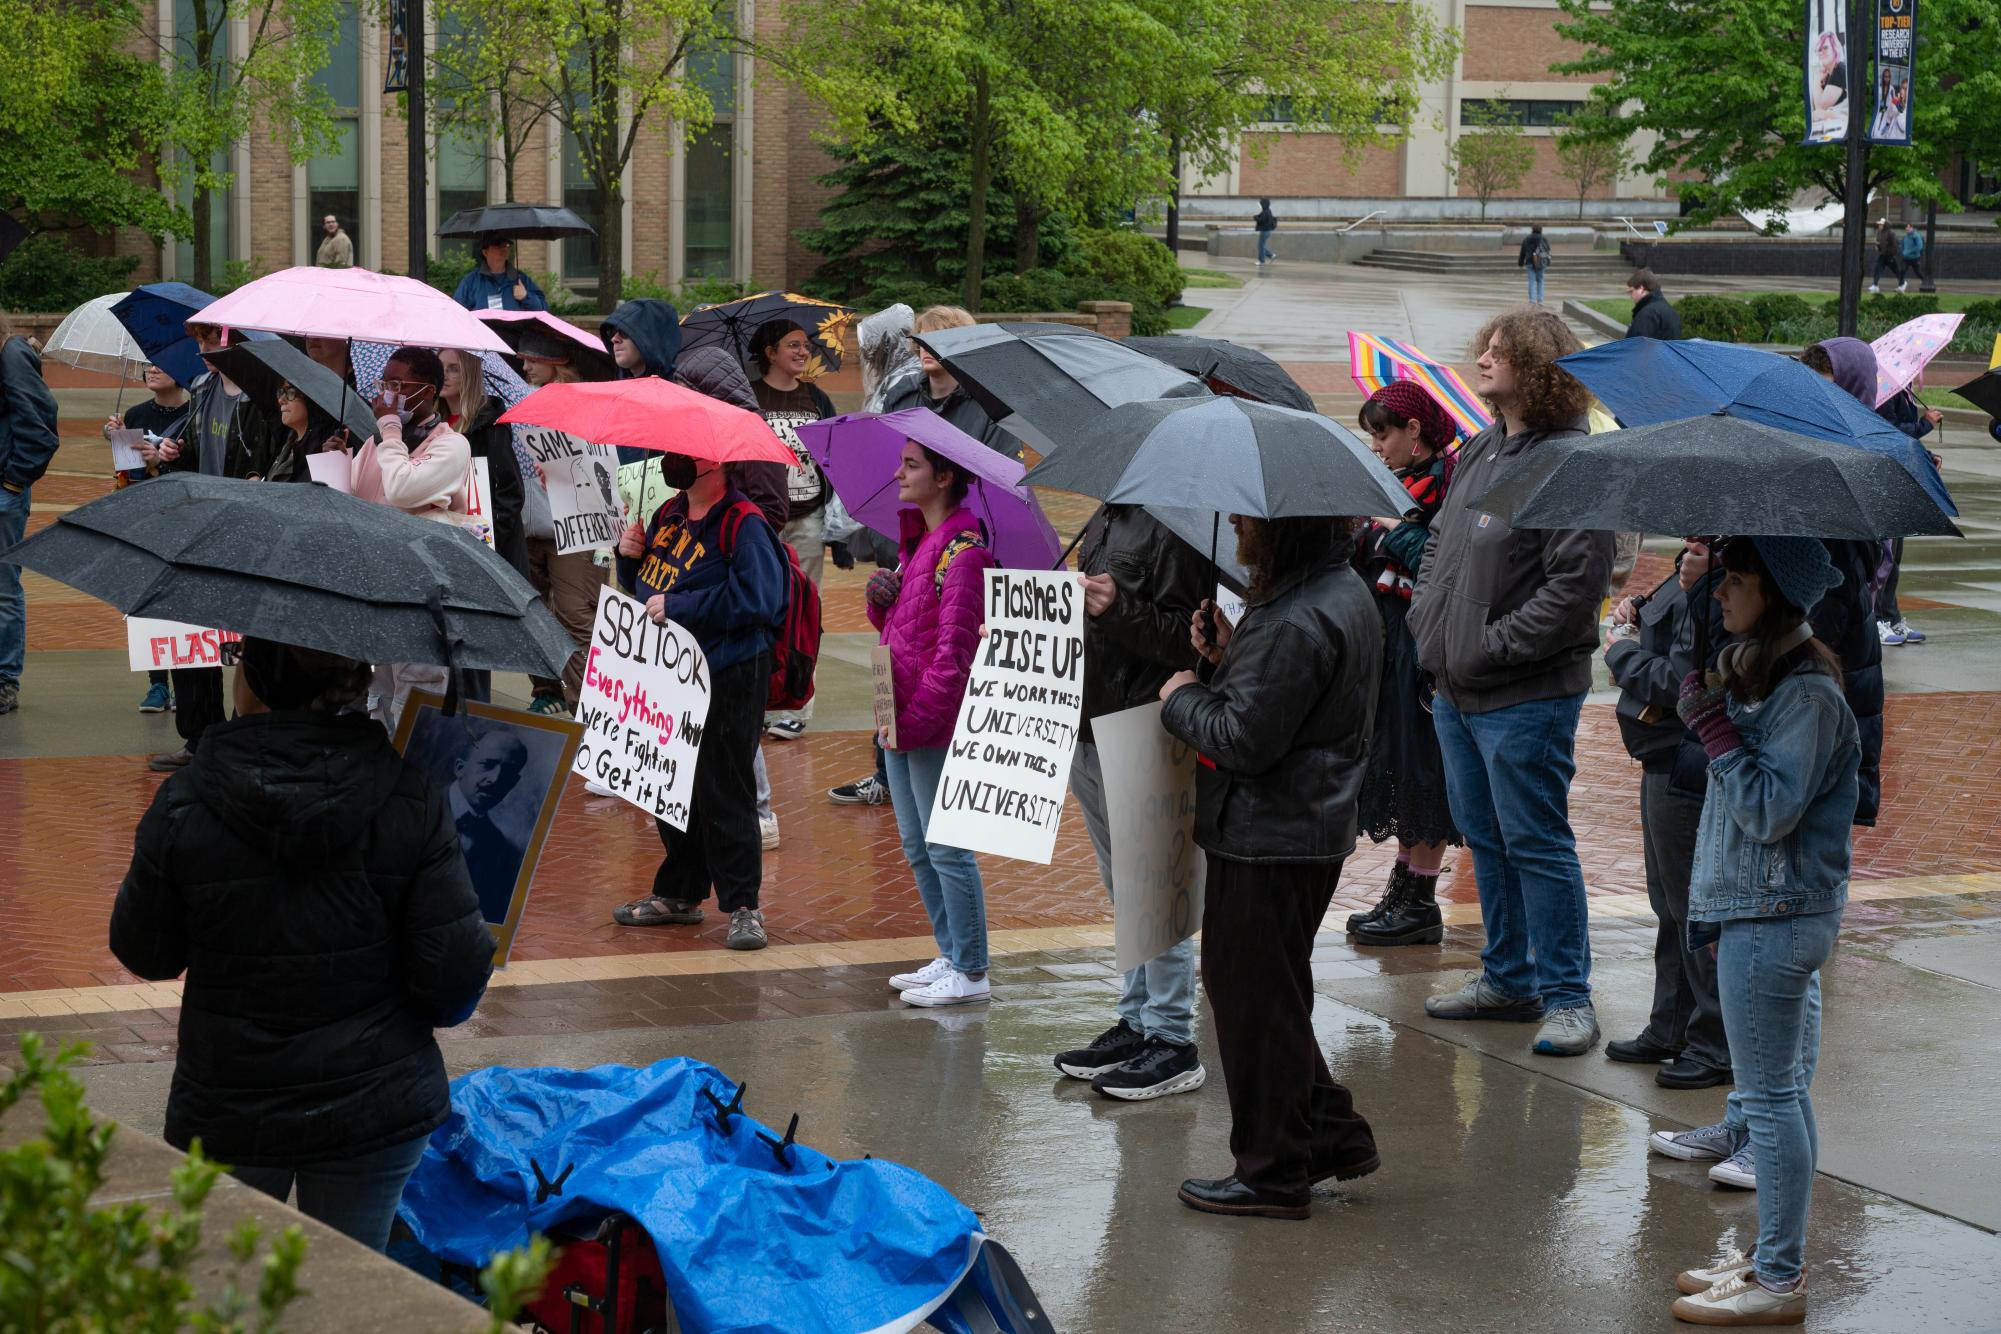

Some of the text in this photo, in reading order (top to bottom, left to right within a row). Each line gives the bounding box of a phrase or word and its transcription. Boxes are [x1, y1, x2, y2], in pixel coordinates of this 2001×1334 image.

[1881, 29, 1910, 40] RESEARCH
[1881, 39, 1910, 48] UNIVERSITY
[526, 430, 583, 463] SAME
[599, 595, 649, 665] SB1
[984, 628, 1084, 682] RISE UP
[586, 646, 674, 746] Everything
[969, 677, 1081, 709] WE WORK THIS
[966, 704, 1079, 752] UNIVERSITY
[625, 728, 677, 791] Fighting
[952, 739, 1057, 778] WE OWN THIS
[596, 749, 632, 792] Get
[636, 776, 653, 803] it
[655, 785, 688, 825] back
[941, 775, 1063, 833] UNIVERSITY
